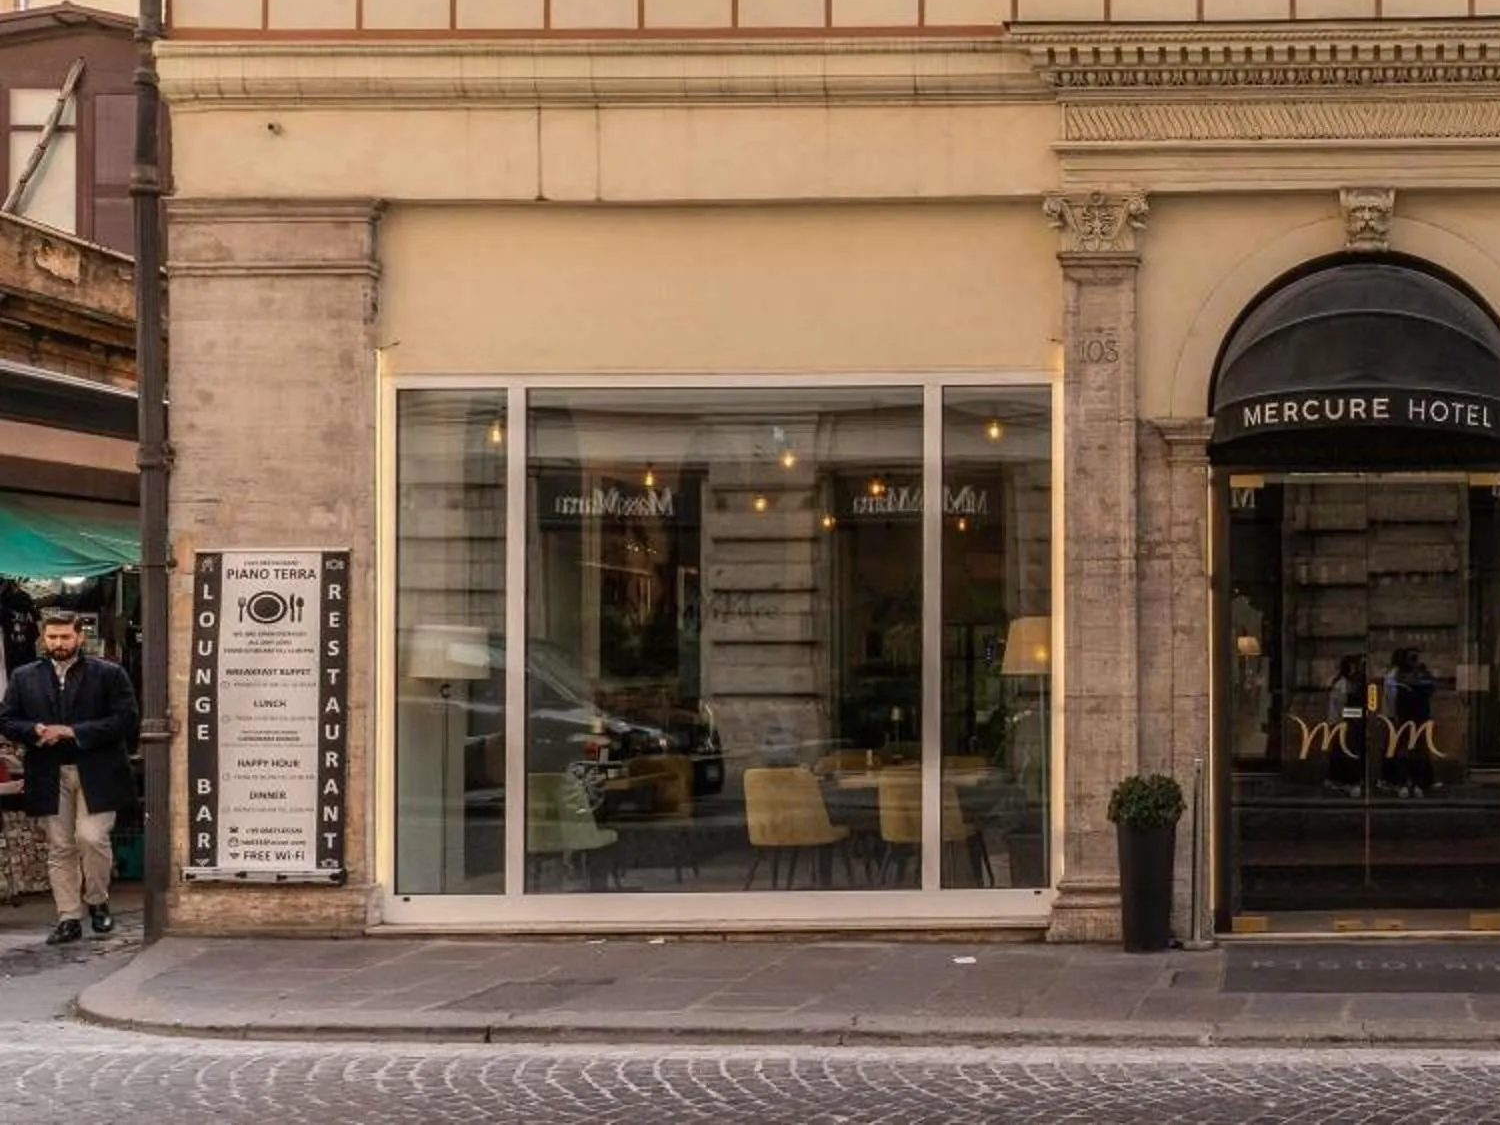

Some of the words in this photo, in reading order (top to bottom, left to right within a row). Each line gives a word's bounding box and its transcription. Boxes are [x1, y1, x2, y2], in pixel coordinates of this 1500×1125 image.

[1243, 398, 1390, 427] MERCURE
[1408, 399, 1492, 428] HOTEL
[226, 568, 270, 580] PIANO
[273, 568, 317, 580] TERRA
[195, 583, 215, 741] LOUNGE
[253, 699, 287, 708] LUNCH
[322, 583, 342, 850] RESTAURANT
[237, 758, 269, 768] HAPPY
[271, 758, 300, 768] HOUR
[248, 790, 288, 800] DINNER
[196, 778, 213, 849] BAR
[243, 850, 271, 861] FREE
